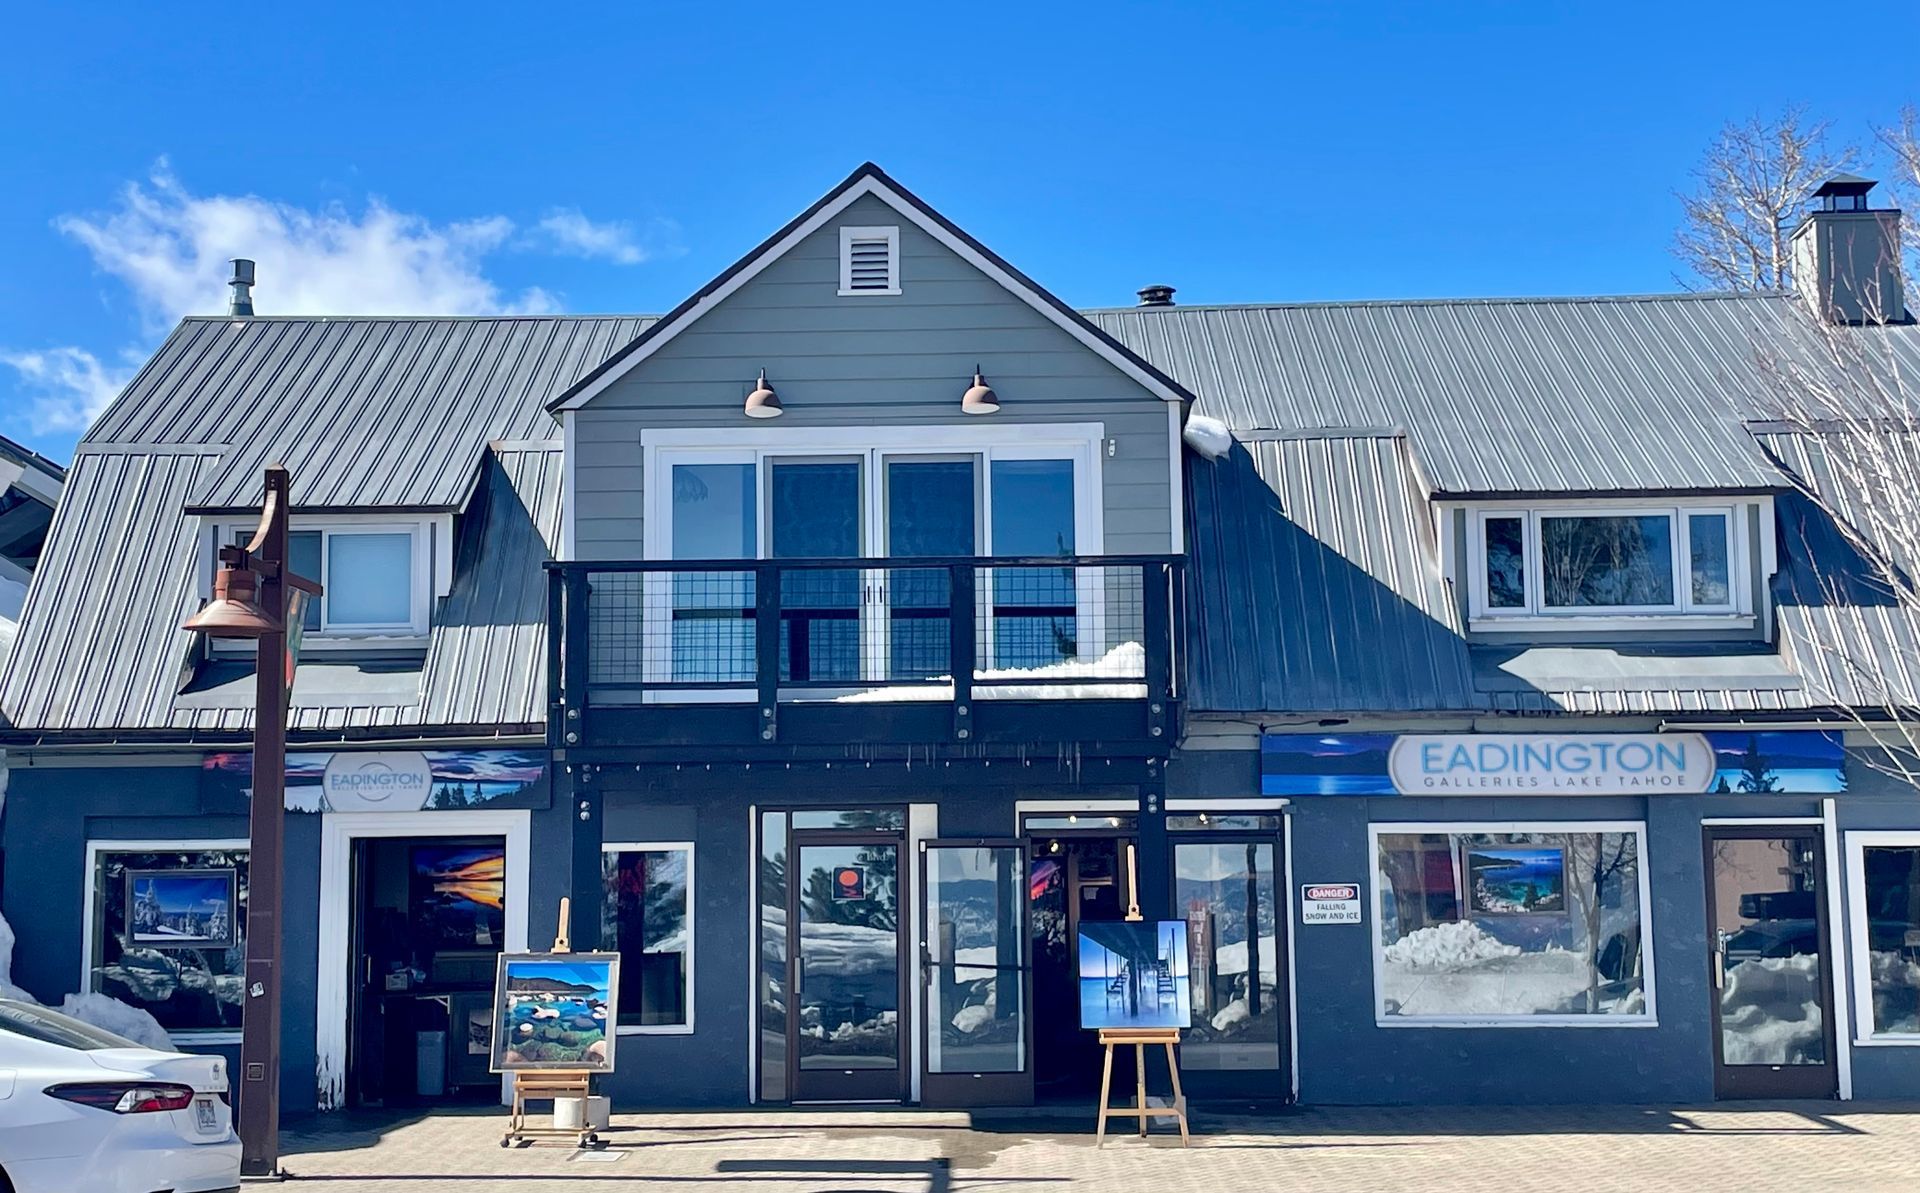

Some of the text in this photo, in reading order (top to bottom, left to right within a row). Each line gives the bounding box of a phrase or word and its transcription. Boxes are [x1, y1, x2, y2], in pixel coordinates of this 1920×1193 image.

[1421, 742, 1686, 773] EADINGTON
[331, 773, 424, 785] EADINGTON
[1424, 775, 1685, 787] GALLERIES LAKE TAHOE
[1313, 888, 1350, 897] DANGER
[1305, 912, 1359, 920] SNOW AND ICE
